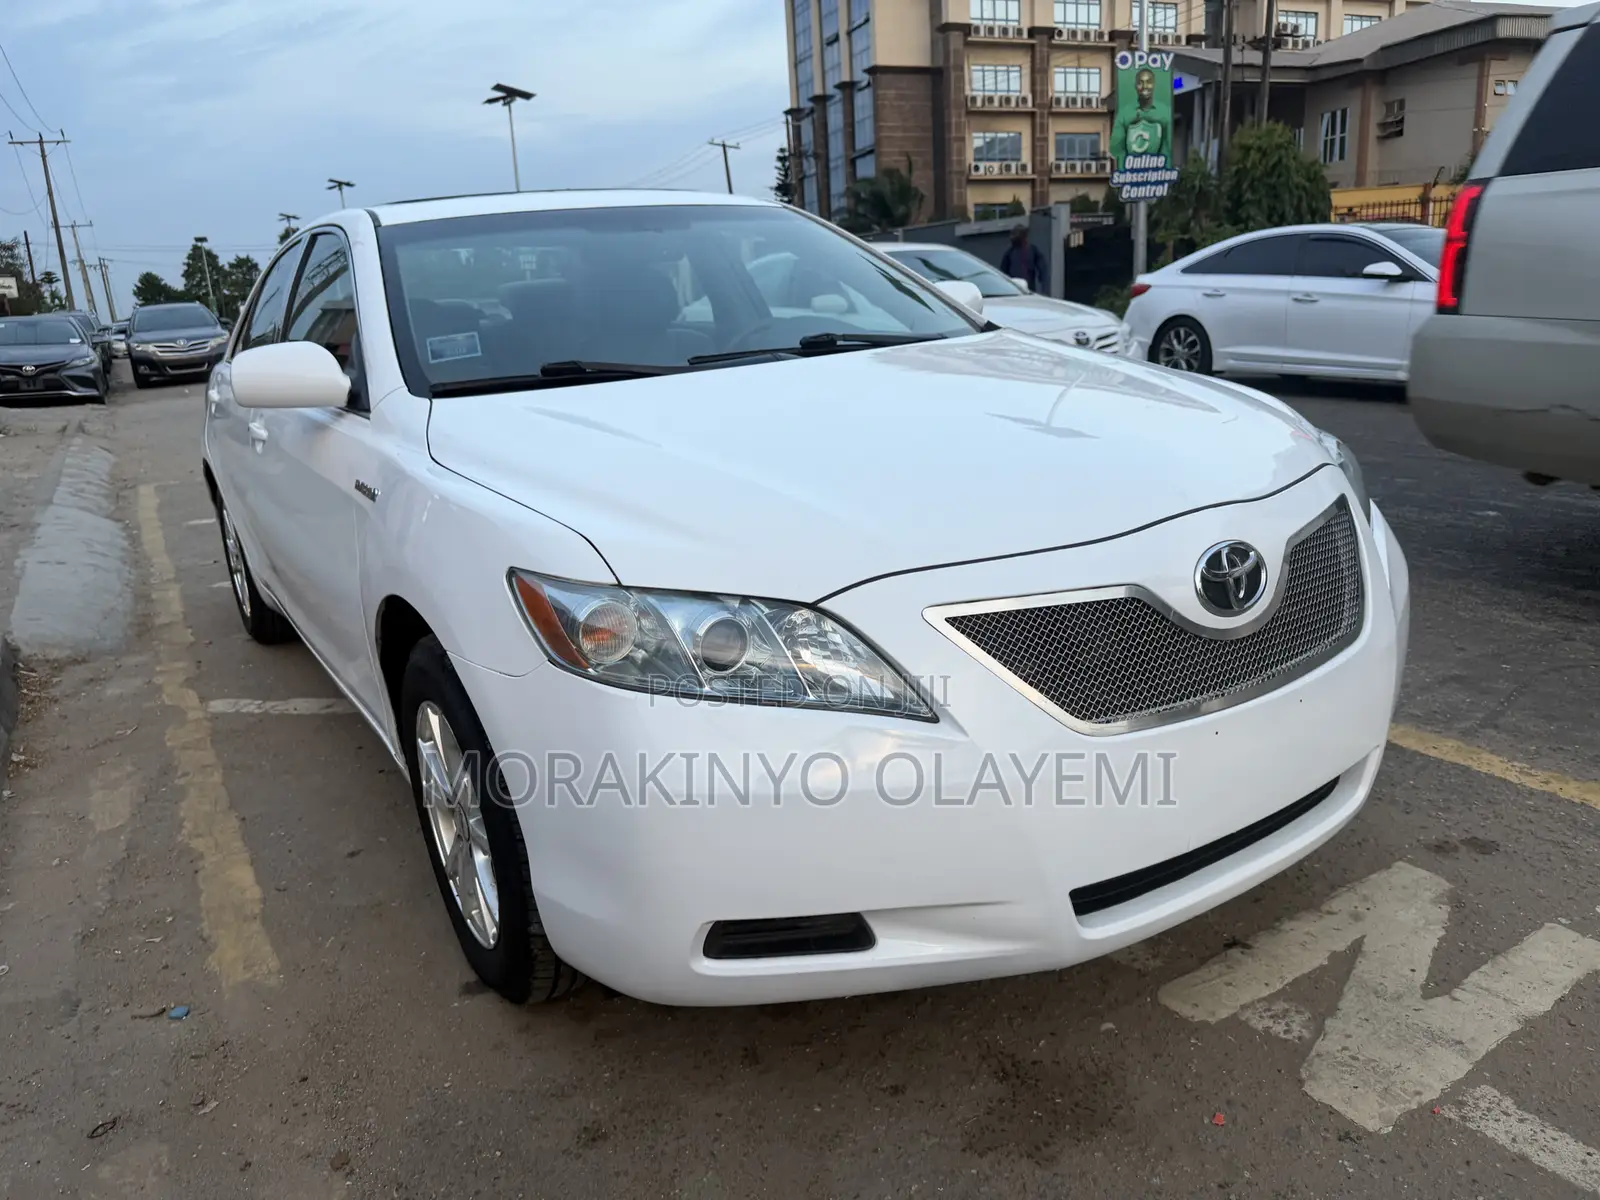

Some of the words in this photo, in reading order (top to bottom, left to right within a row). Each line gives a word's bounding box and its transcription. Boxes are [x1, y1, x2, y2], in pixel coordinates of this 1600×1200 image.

[1125, 155, 1165, 169] Online
[1112, 170, 1178, 183] Subscription
[1121, 183, 1168, 198] Control
